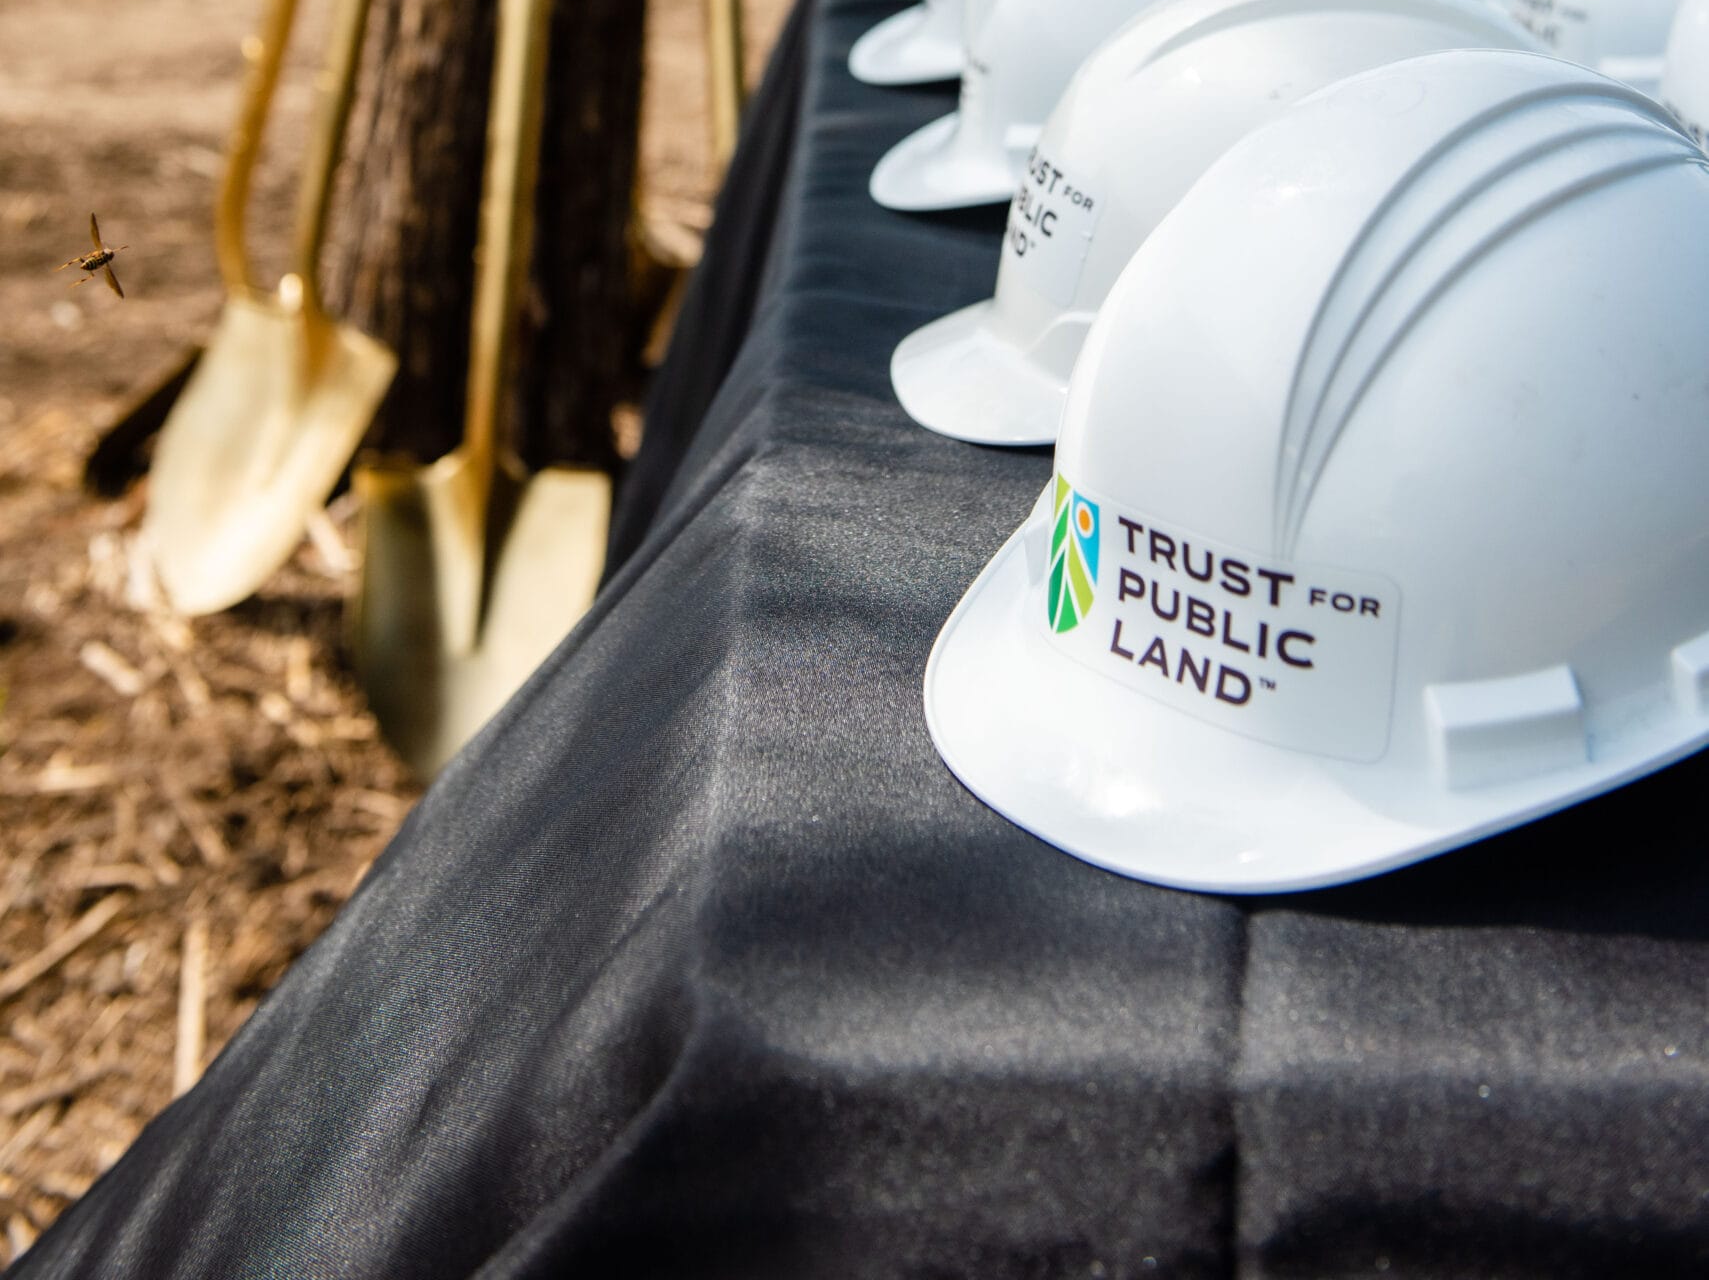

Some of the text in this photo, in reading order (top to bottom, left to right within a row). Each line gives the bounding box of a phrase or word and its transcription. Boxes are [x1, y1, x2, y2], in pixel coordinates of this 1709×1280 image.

[1062, 184, 1095, 212] FOR
[1117, 514, 1381, 618] TRUST FOR
[1117, 566, 1317, 669] PUBLIC
